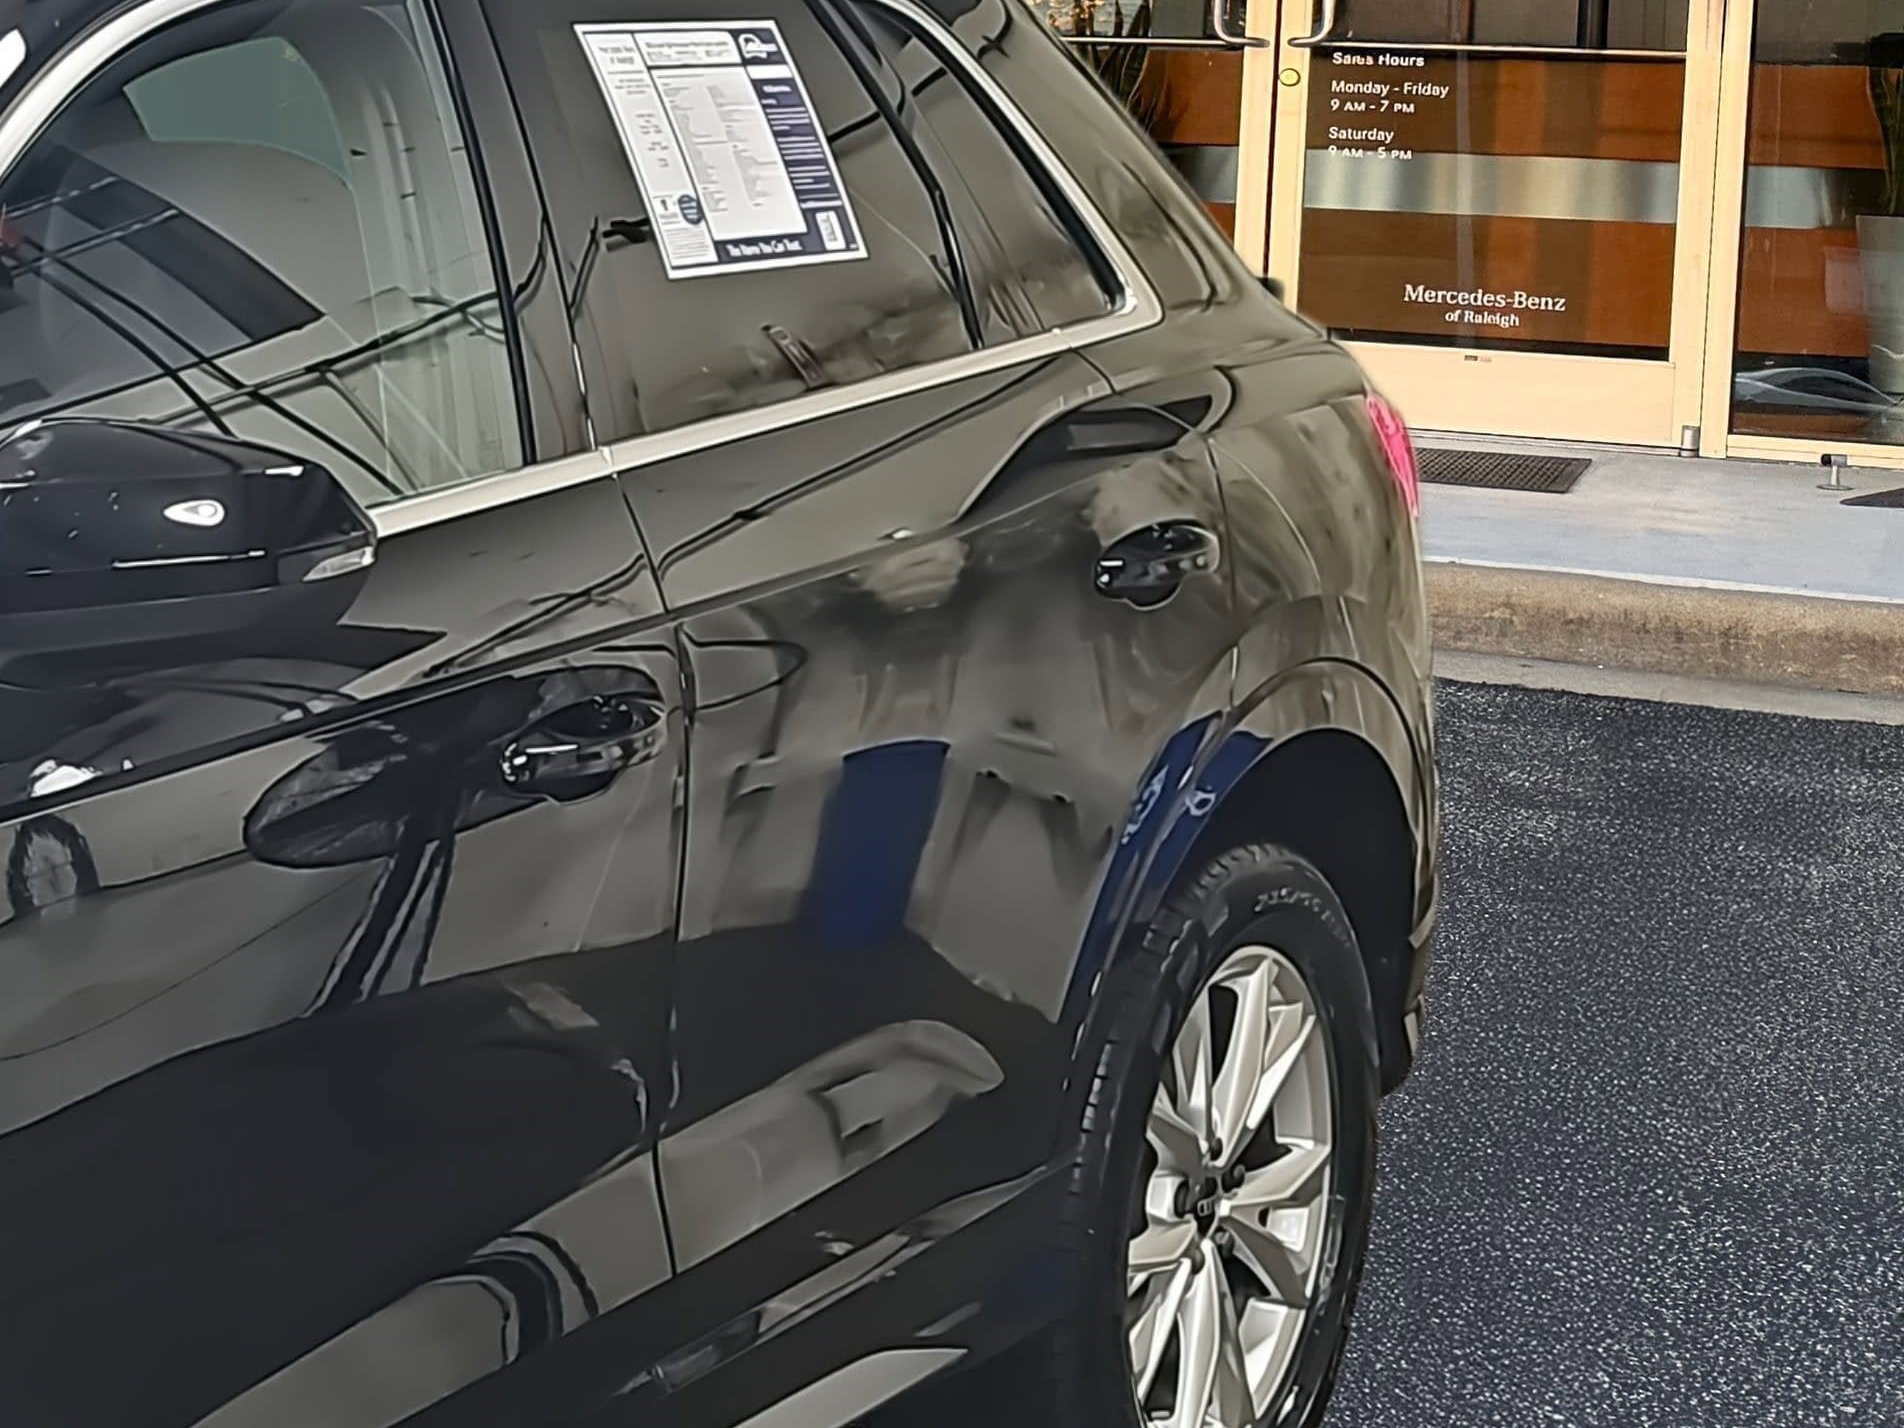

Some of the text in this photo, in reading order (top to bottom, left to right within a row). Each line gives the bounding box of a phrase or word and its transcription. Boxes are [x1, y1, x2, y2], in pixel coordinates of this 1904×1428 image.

[1378, 53, 1425, 67] Hours
[1331, 80, 1390, 97] Monday
[1403, 82, 1449, 98] Friday
[1330, 99, 1340, 111] 9
[1344, 101, 1365, 112] AM
[1380, 100, 1389, 112] 7
[1393, 103, 1415, 113] PM
[1328, 127, 1394, 143] Saturday
[1328, 145, 1337, 157] 9
[1378, 147, 1386, 158] 5
[1391, 150, 1412, 160] PM
[1403, 284, 1566, 311] Mercedes-Benz
[1445, 310, 1520, 328] of Raleigh
